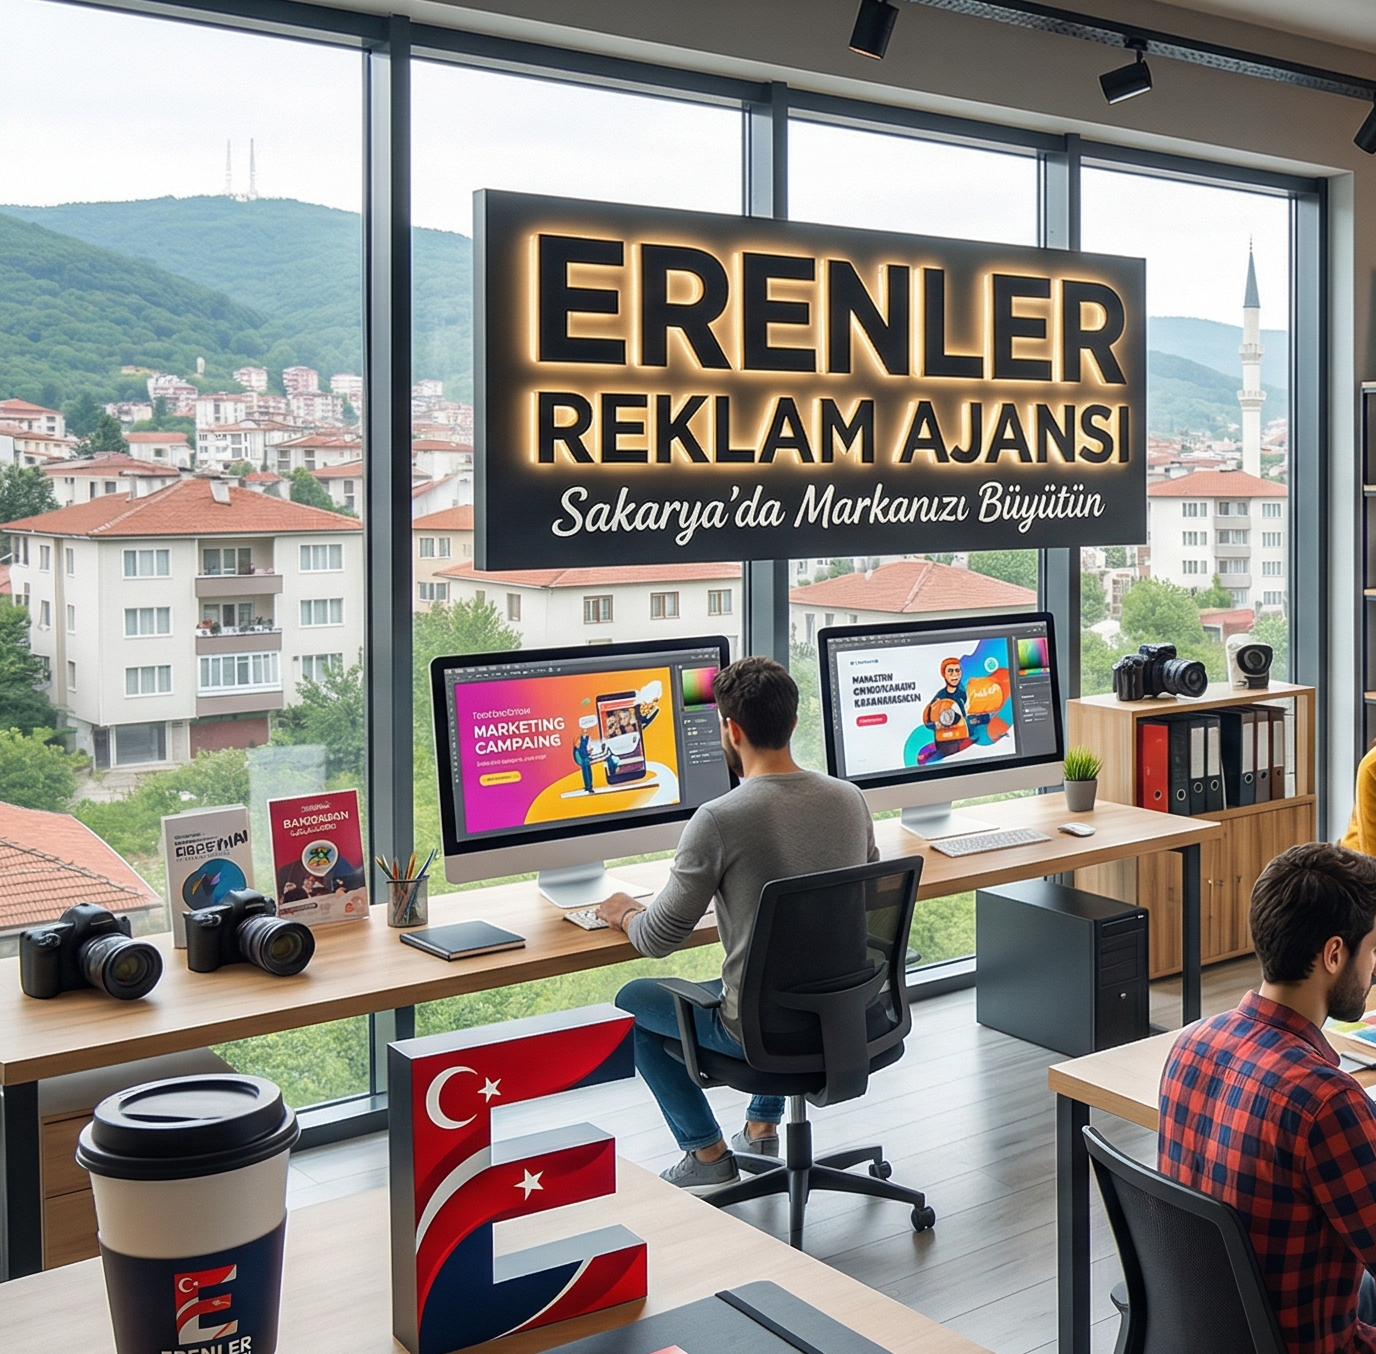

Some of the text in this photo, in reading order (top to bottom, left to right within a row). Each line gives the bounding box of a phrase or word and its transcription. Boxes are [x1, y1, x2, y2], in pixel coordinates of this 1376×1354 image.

[532, 233, 1128, 385] ERENLER
[533, 391, 1130, 464] REKLAM AJANSI
[551, 480, 1106, 547] Sakarya'da Markanızı Büyütün
[474, 717, 565, 739] MARKETING
[475, 734, 562, 755] CAMPAING
[411, 1016, 649, 1354] E
[161, 1335, 252, 1354] NLER
